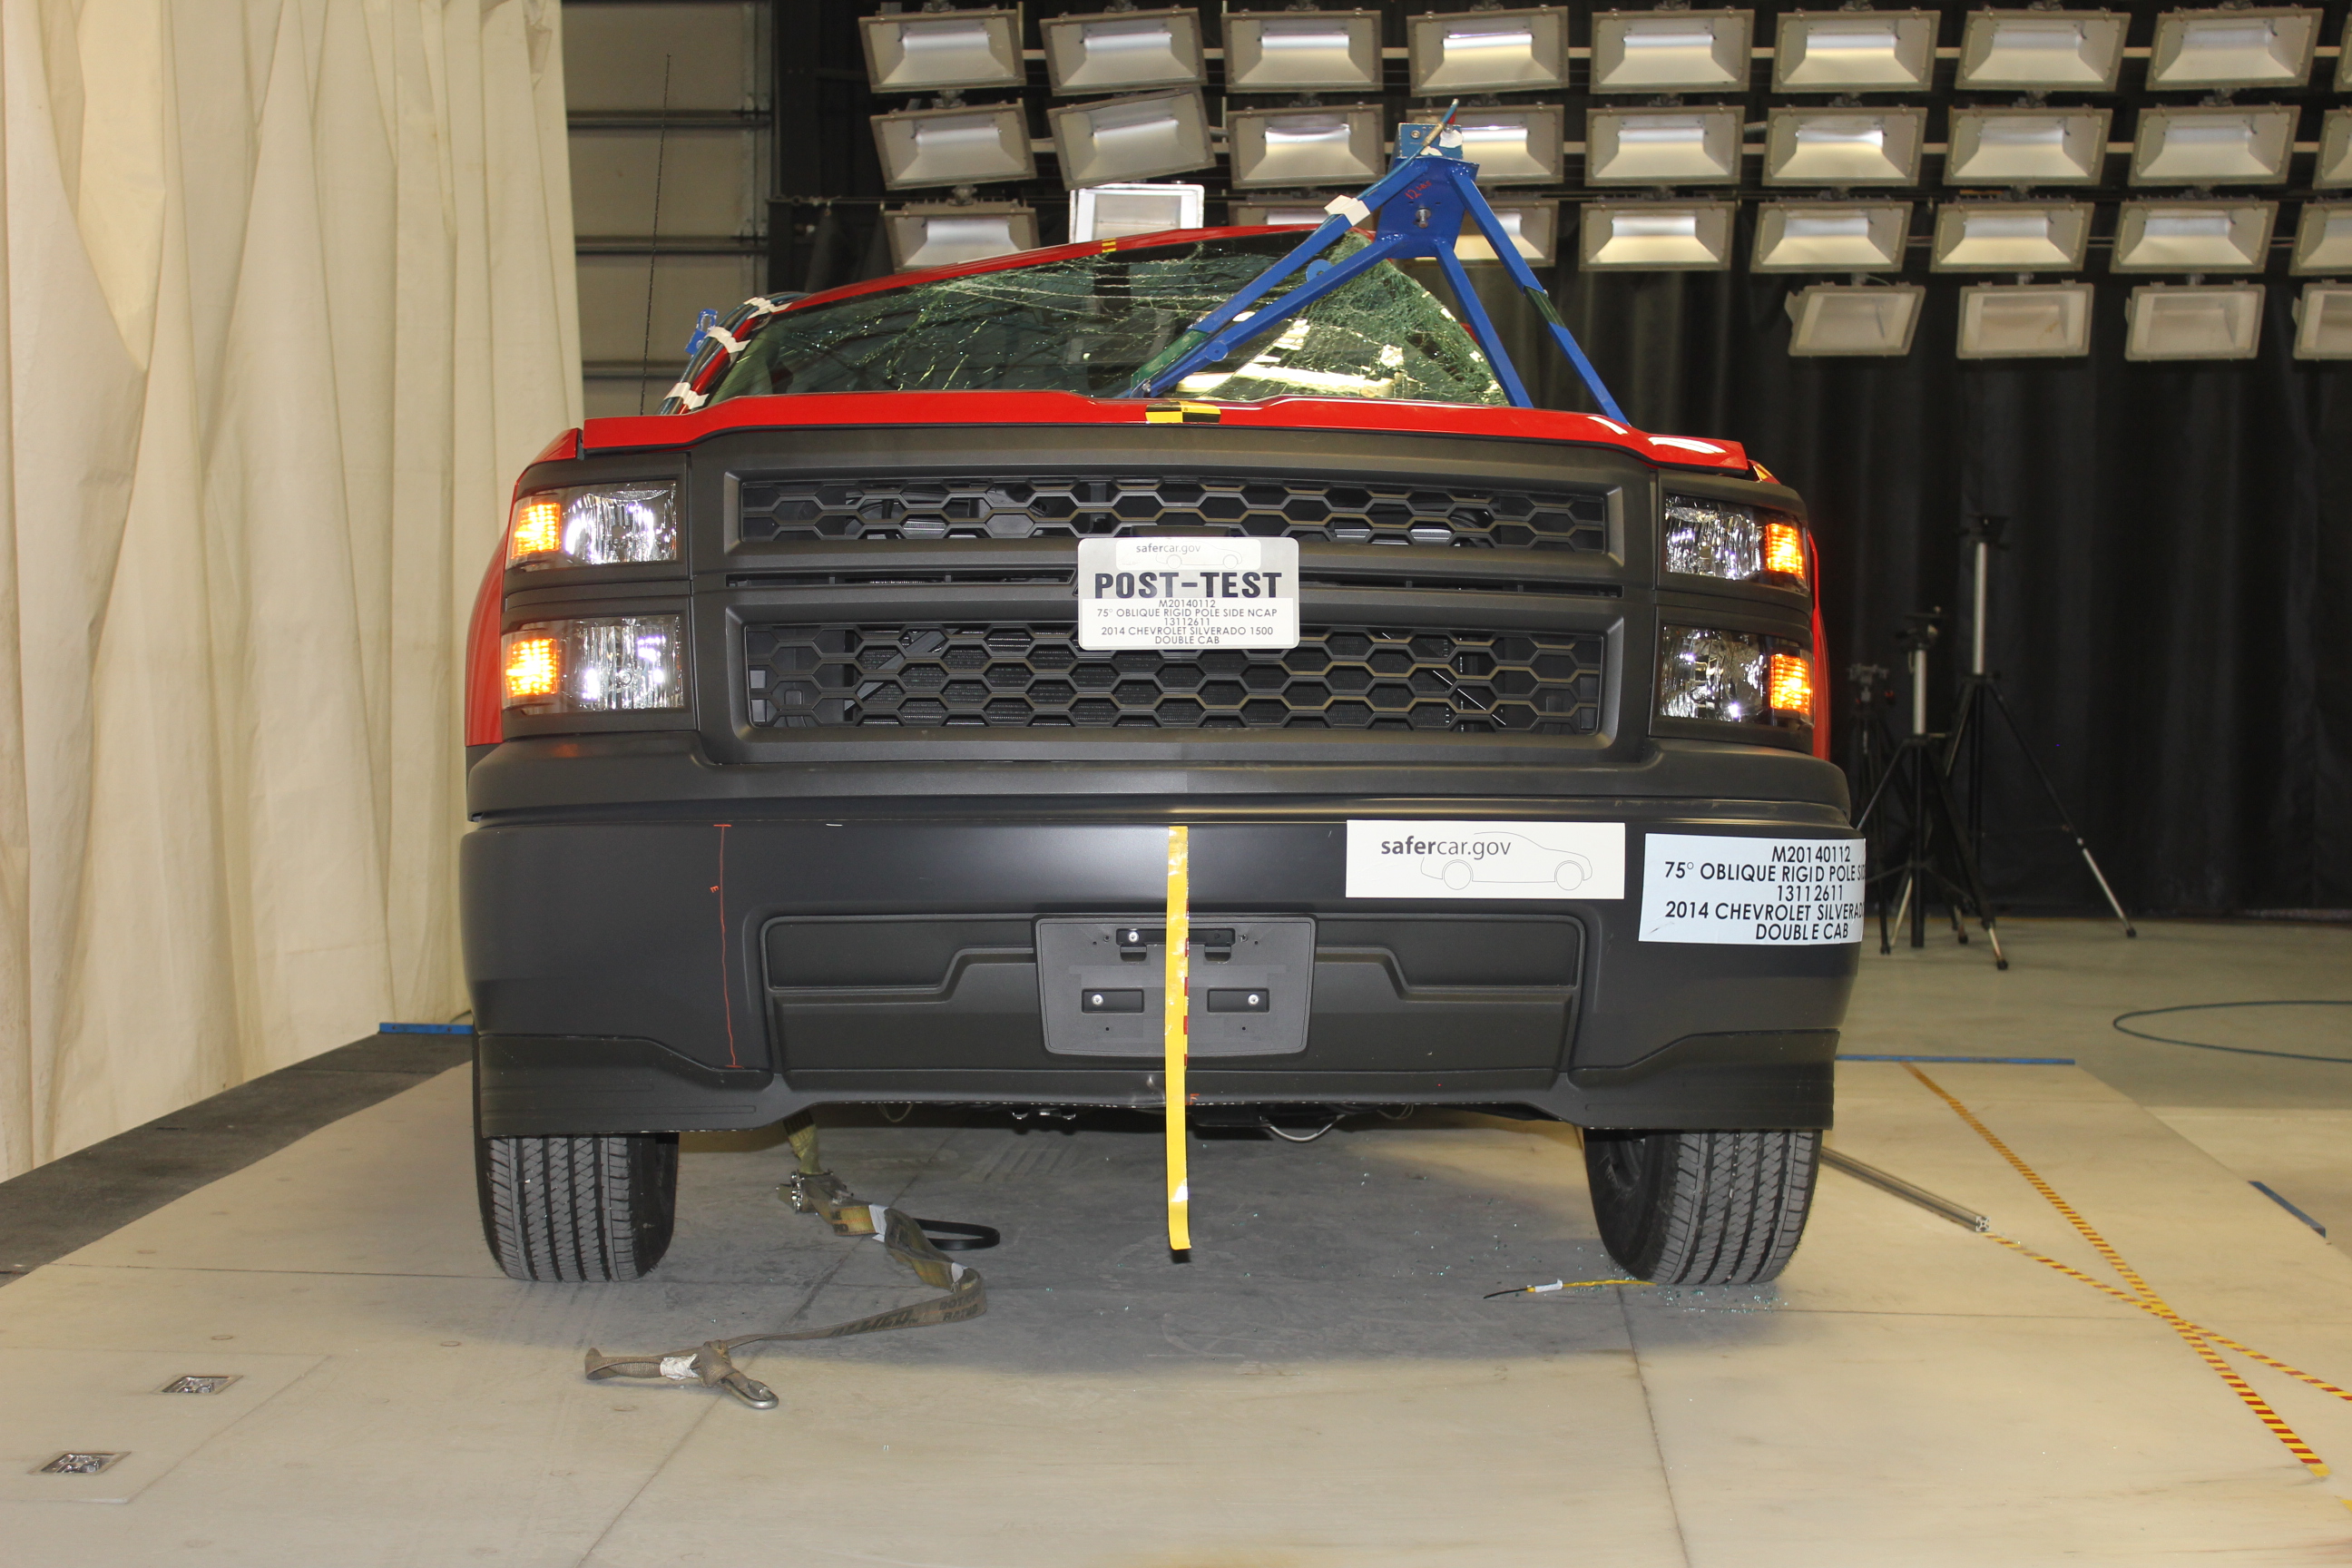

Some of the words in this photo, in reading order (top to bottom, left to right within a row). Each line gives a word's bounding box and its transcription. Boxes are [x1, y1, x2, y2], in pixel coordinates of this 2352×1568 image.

[1136, 544, 1200, 554] safercar.gov
[1094, 572, 1282, 599] POST-TEST
[1158, 599, 1216, 608] M20140112
[1097, 608, 1113, 617] 75°
[1116, 608, 1161, 618] OBLIQUE
[1163, 608, 1191, 617] RIGID
[1195, 608, 1220, 617] POLE
[1223, 608, 1244, 617] SIDE
[1248, 608, 1278, 617] NCAP
[1164, 617, 1210, 626] 13112611
[1101, 626, 1125, 635] 2014
[1128, 626, 1187, 635] CHEVROLET
[1190, 626, 1246, 635] SILVERADO
[1250, 626, 1274, 635] 1500
[1154, 635, 1194, 644] DOUBLE
[1197, 635, 1220, 644] CAB
[1380, 835, 1512, 861] safercar.gov
[1771, 845, 1851, 864] M20140112
[1664, 860, 1694, 879] 75°
[1700, 862, 1776, 883] OBLIQUE
[1781, 865, 1825, 883] RIGID
[1829, 865, 1856, 882] POLE
[1777, 884, 1843, 902] 13112611
[1664, 900, 1709, 919] 2014
[1715, 902, 1811, 921] CHEVROLET
[1756, 923, 1819, 941] DOUBLE
[1823, 922, 1848, 940] CAB
